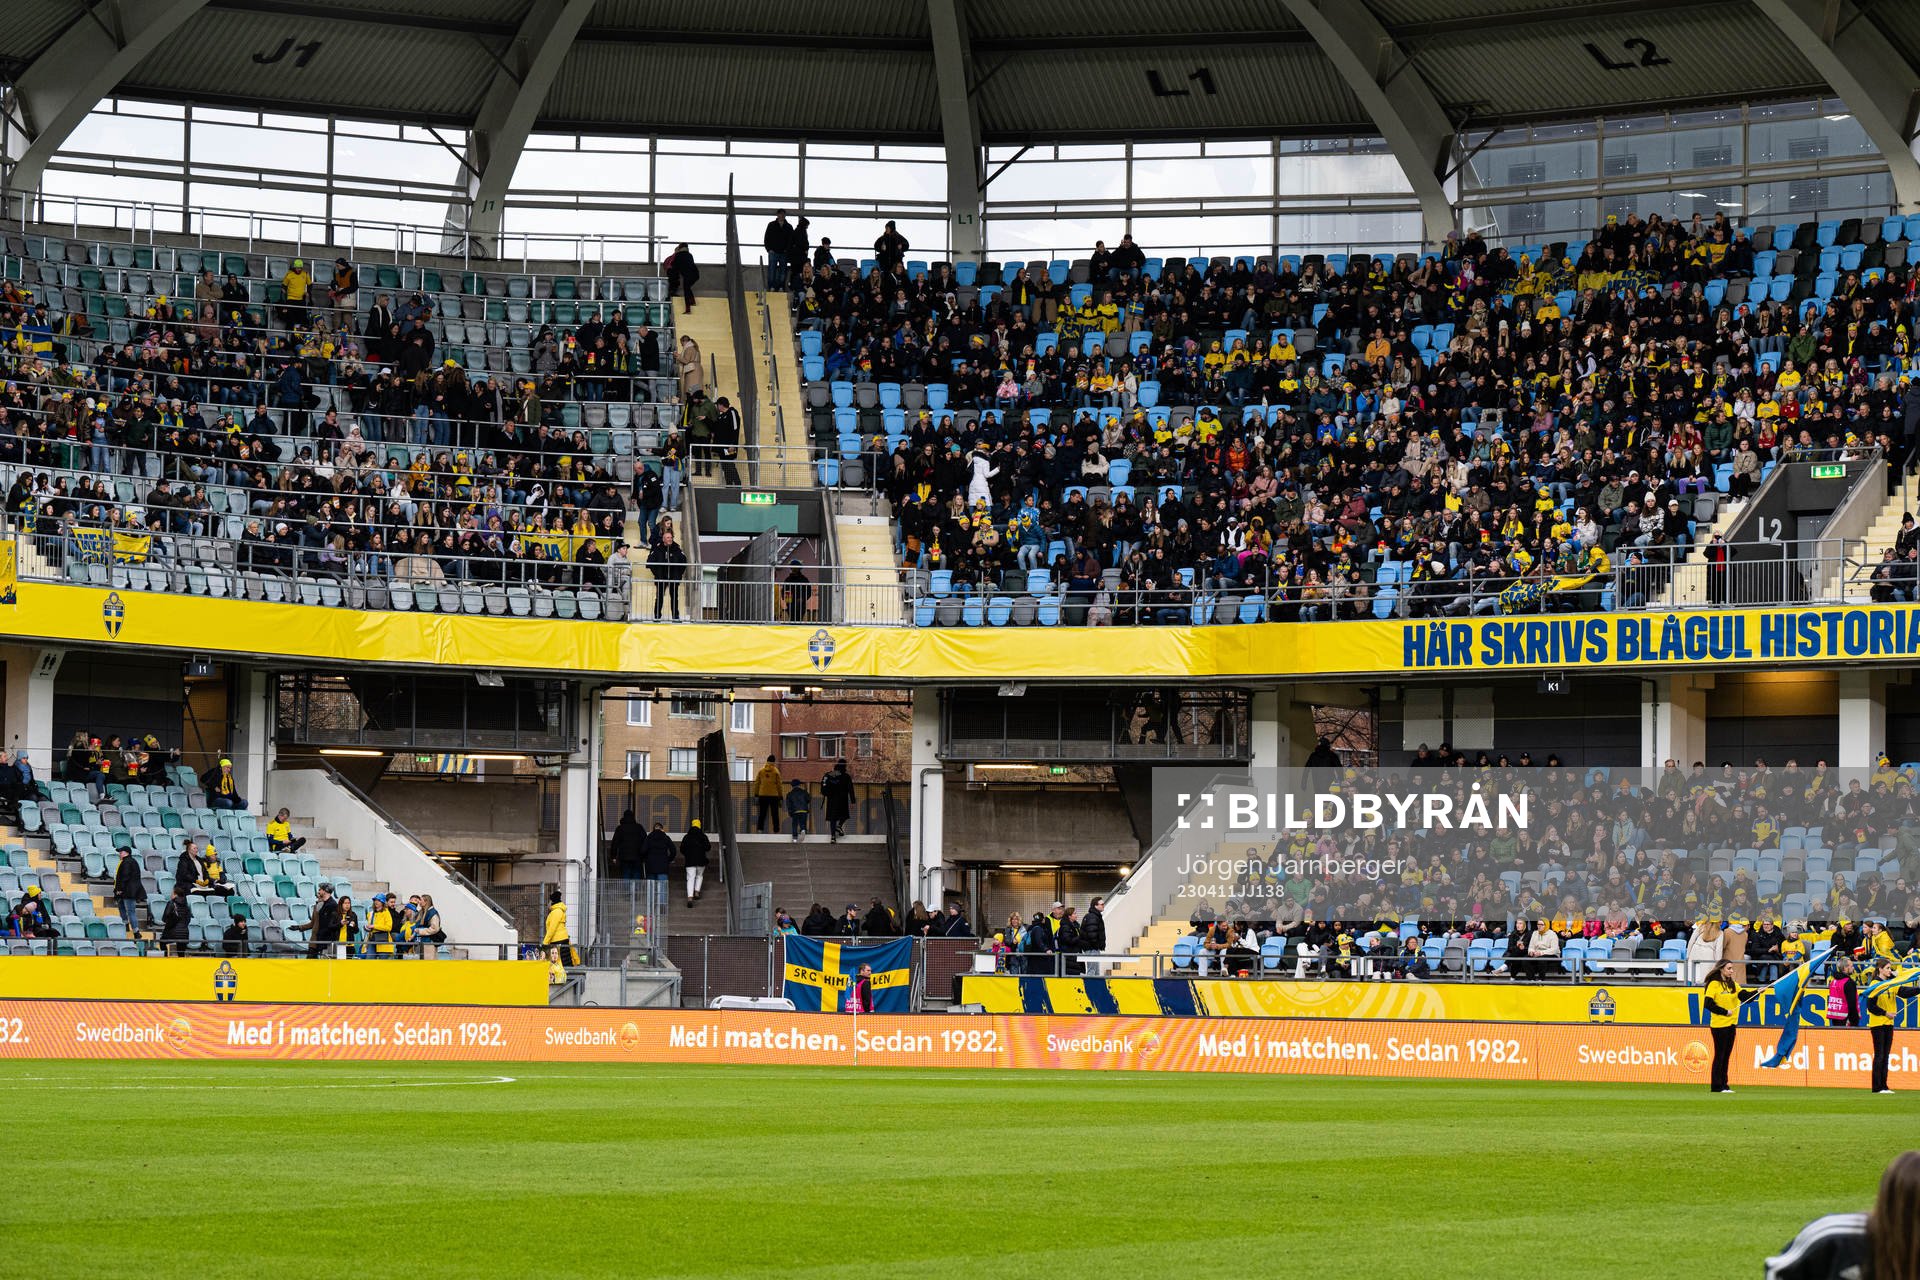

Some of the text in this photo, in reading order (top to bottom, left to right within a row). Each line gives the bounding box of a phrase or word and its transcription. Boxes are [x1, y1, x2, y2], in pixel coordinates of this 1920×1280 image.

[253, 39, 322, 67] J1
[1583, 38, 1672, 70] L2
[1146, 68, 1216, 96] L1
[481, 199, 495, 213] J1
[958, 214, 973, 224] L1
[1759, 517, 1783, 546] L2
[1403, 621, 1473, 667] HÄR
[1481, 619, 1608, 666] SKRIVS
[1617, 614, 1753, 662] BLÅGUL
[1548, 682, 1559, 692] K1
[76, 1022, 165, 1043] Swedbank
[227, 1020, 507, 1047] Med i matchen. Sedan 1982.
[545, 1027, 617, 1046] Swedbank
[670, 1025, 1004, 1053] Med i matchen. Sedan 1982.
[1047, 1034, 1134, 1054] Swedbank
[1198, 1034, 1528, 1064] Med i matchen. Sedan 1982.
[1578, 1045, 1678, 1066] Swedbank
[1818, 1045, 1825, 1071] i
[1835, 1046, 1918, 1073] mach
